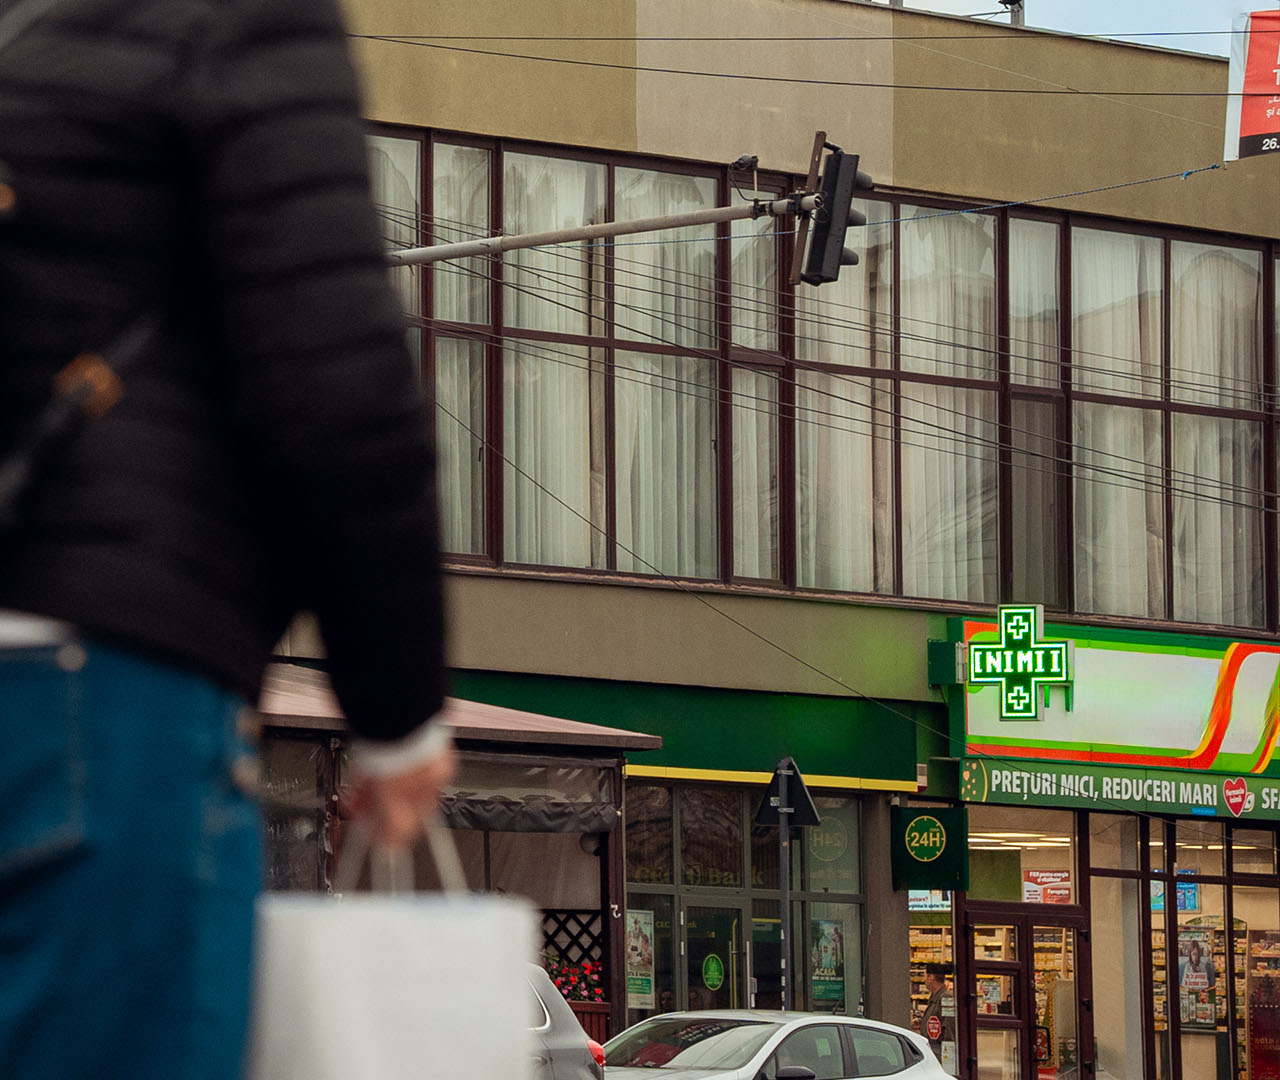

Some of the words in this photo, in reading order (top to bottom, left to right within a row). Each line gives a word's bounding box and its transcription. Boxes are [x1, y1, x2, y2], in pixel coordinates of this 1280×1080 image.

[991, 769, 1056, 800] PREȚURI
[1060, 774, 1099, 802] MICI,
[1102, 777, 1176, 803] REDUCERI
[1179, 781, 1218, 806] MARI
[911, 832, 940, 847] 24H
